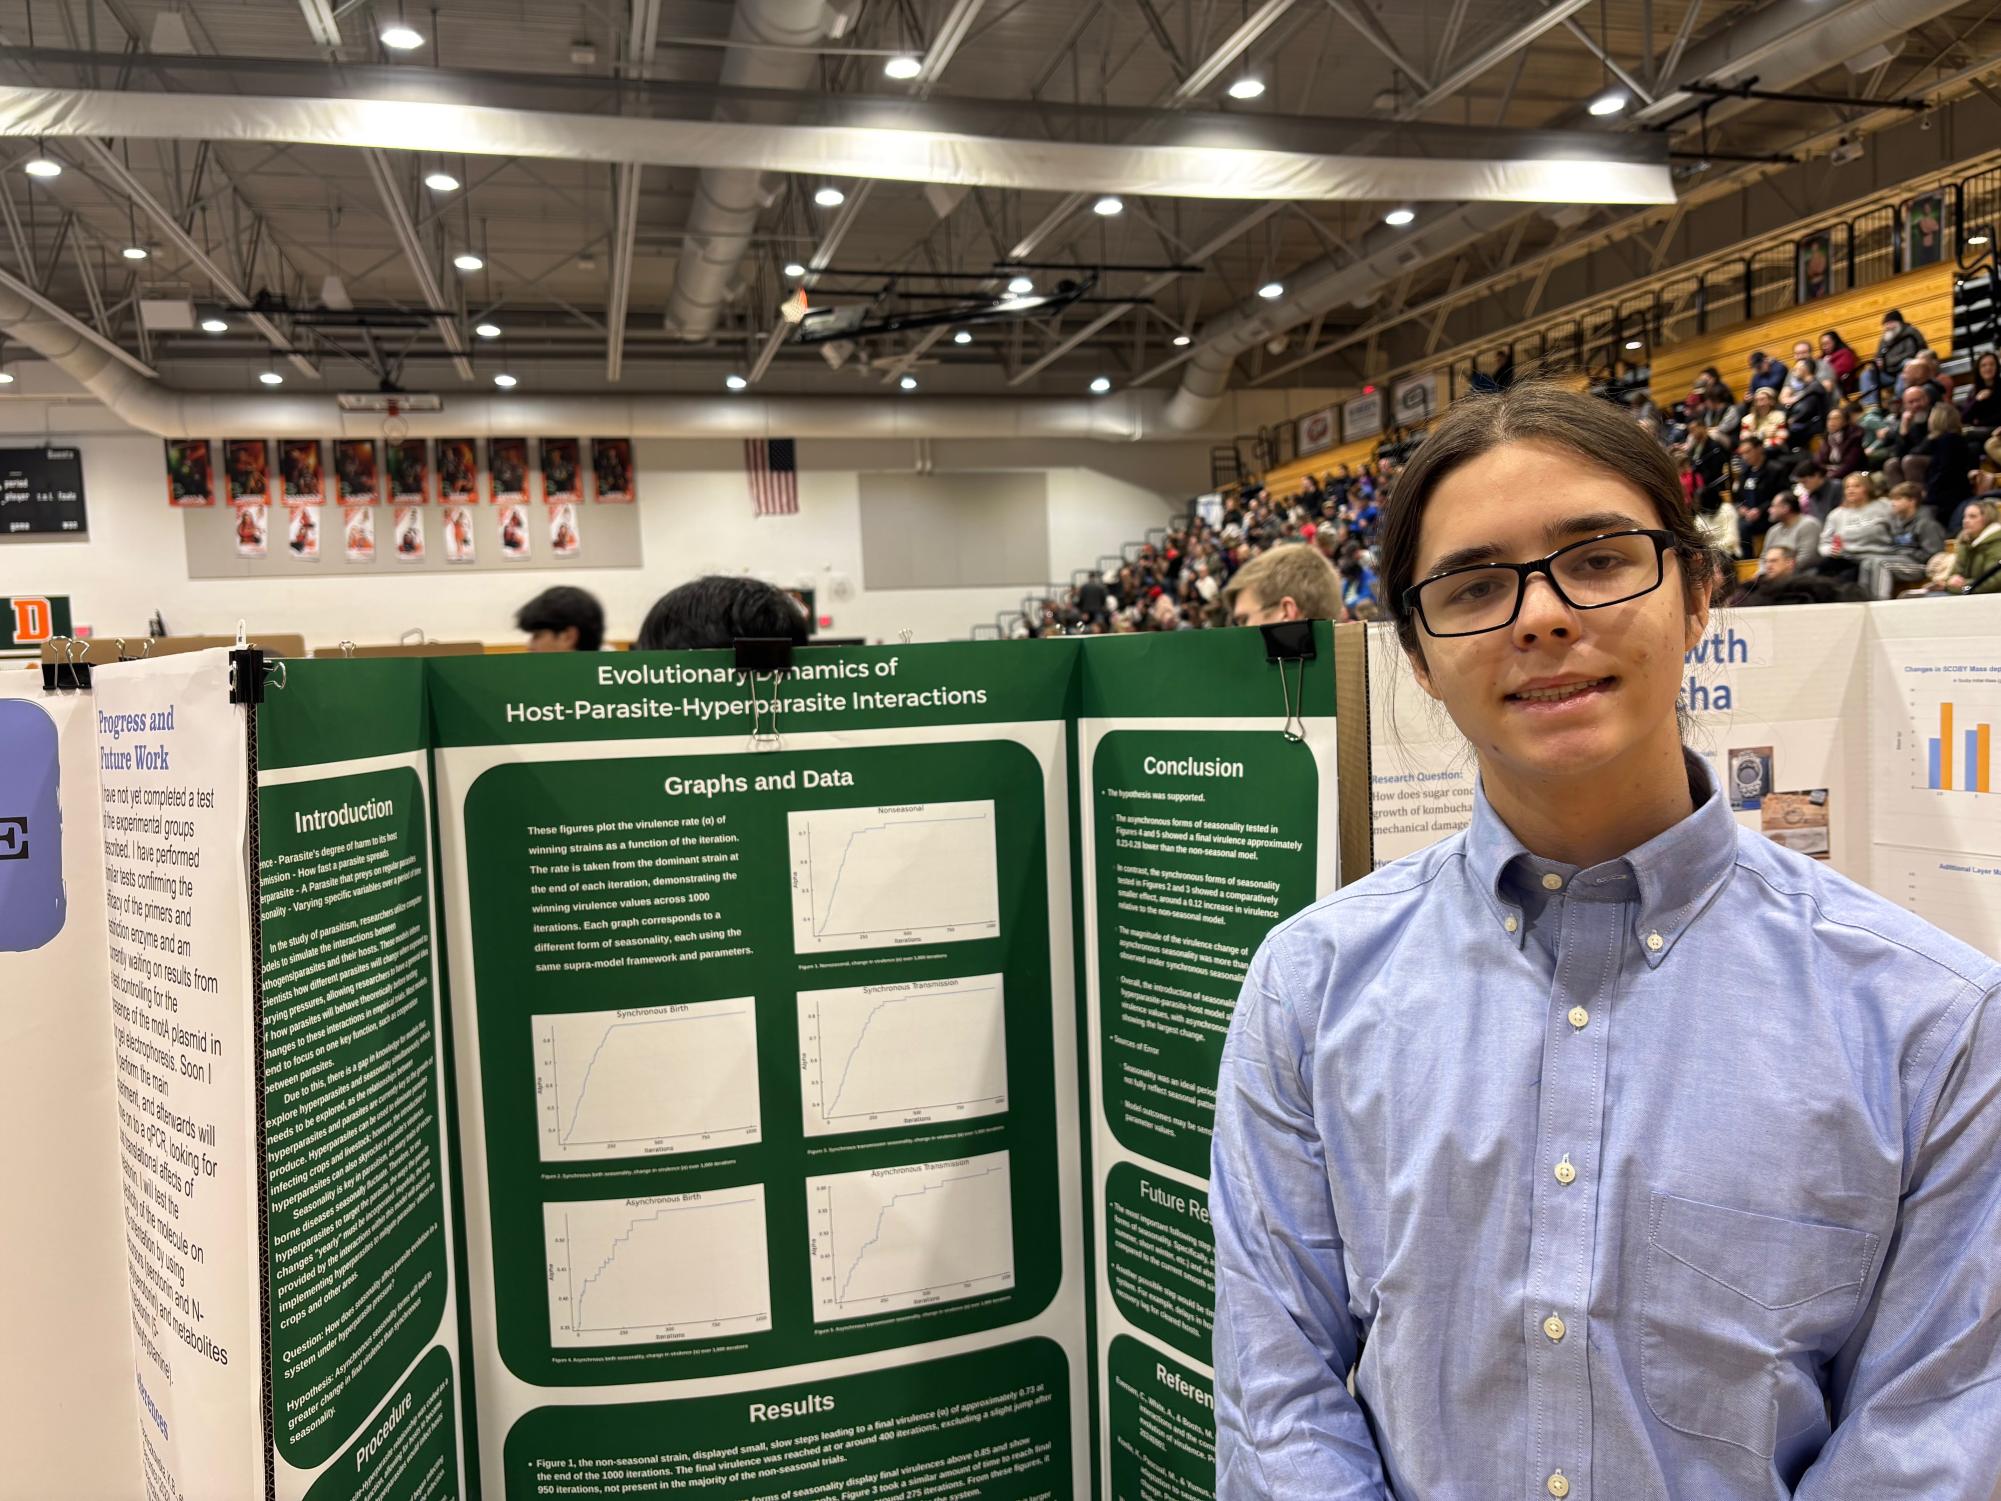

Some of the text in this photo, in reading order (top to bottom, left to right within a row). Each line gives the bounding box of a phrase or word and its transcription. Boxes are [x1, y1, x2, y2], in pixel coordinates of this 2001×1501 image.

[12, 598, 52, 642] D
[598, 664, 747, 687] Evolutionary
[875, 657, 899, 676] of
[506, 686, 987, 723] Host-Parasite-Hyperparasite Interactions
[1680, 677, 1732, 710] ha
[99, 705, 174, 740] Progress and
[134, 744, 169, 770] Work
[1143, 756, 1244, 778] Conclusion
[664, 769, 854, 797] Graphs and Data
[1372, 772, 1463, 784] Research Question:
[118, 786, 214, 811] not yet completed a test
[1167, 793, 1205, 802] supported.
[1373, 792, 1395, 801] How
[1398, 790, 1420, 799] does
[1423, 790, 1449, 799] sugar
[295, 798, 393, 833] Introduction
[878, 805, 924, 814] Nonseasonal
[1373, 802, 1472, 819] growth of kombucha
[117, 812, 194, 841] experimental groups
[528, 826, 557, 835] These
[560, 825, 594, 835] figures
[597, 823, 615, 833] plot
[618, 822, 633, 830] the
[636, 819, 679, 829] virulence
[681, 818, 699, 826] rate
[717, 815, 726, 824] of
[1204, 820, 1244, 833] seasonality
[1373, 822, 1428, 835] mechanical
[137, 840, 153, 862] have
[156, 844, 199, 868] performed
[279, 840, 371, 864] Parasite's degree of harm
[529, 845, 567, 855] winning
[570, 843, 603, 852] strains
[606, 842, 617, 850] as
[628, 839, 668, 849] function
[670, 837, 679, 846] of
[682, 837, 696, 845] the
[699, 834, 740, 844] iteration.
[1247, 838, 1303, 851] approximately
[298, 867, 316, 877] How
[318, 863, 331, 873] fast
[338, 855, 366, 871] parasite
[367, 849, 389, 863] spreads
[530, 853, 739, 874] The rate is taken from the dominant strain at
[120, 867, 192, 899] tests confirming the
[302, 871, 373, 893] A Parasite that preys
[531, 872, 737, 893] the end of each iteration, demonstrating the
[532, 893, 710, 914] winning virulence values across 1000
[533, 922, 582, 933] iterations.
[584, 921, 608, 930] Each
[611, 918, 639, 929] graph
[641, 913, 701, 926] corresponds
[703, 912, 713, 920] to
[534, 928, 742, 952] different form of seasonality, each using the
[536, 947, 753, 972] same supra-model framework and parameters.
[164, 966, 218, 994] results from
[863, 979, 959, 994] Synchronous Transmission
[616, 1005, 689, 1019] Synchronous Birth
[171, 1023, 222, 1056] plasmid in
[180, 1055, 204, 1083] Soon
[871, 1159, 969, 1178] Asynchronous Transmission
[626, 1193, 701, 1207] Asynchronous Birth
[1141, 1180, 1213, 1226] Future Re
[283, 1330, 324, 1363] Question:
[286, 1375, 334, 1412] Hypothesis:
[749, 1394, 836, 1423] Results
[356, 1392, 412, 1472] Procedure
[536, 1441, 768, 1469] Figure 1, the non-seasonal strain, displayed small,
